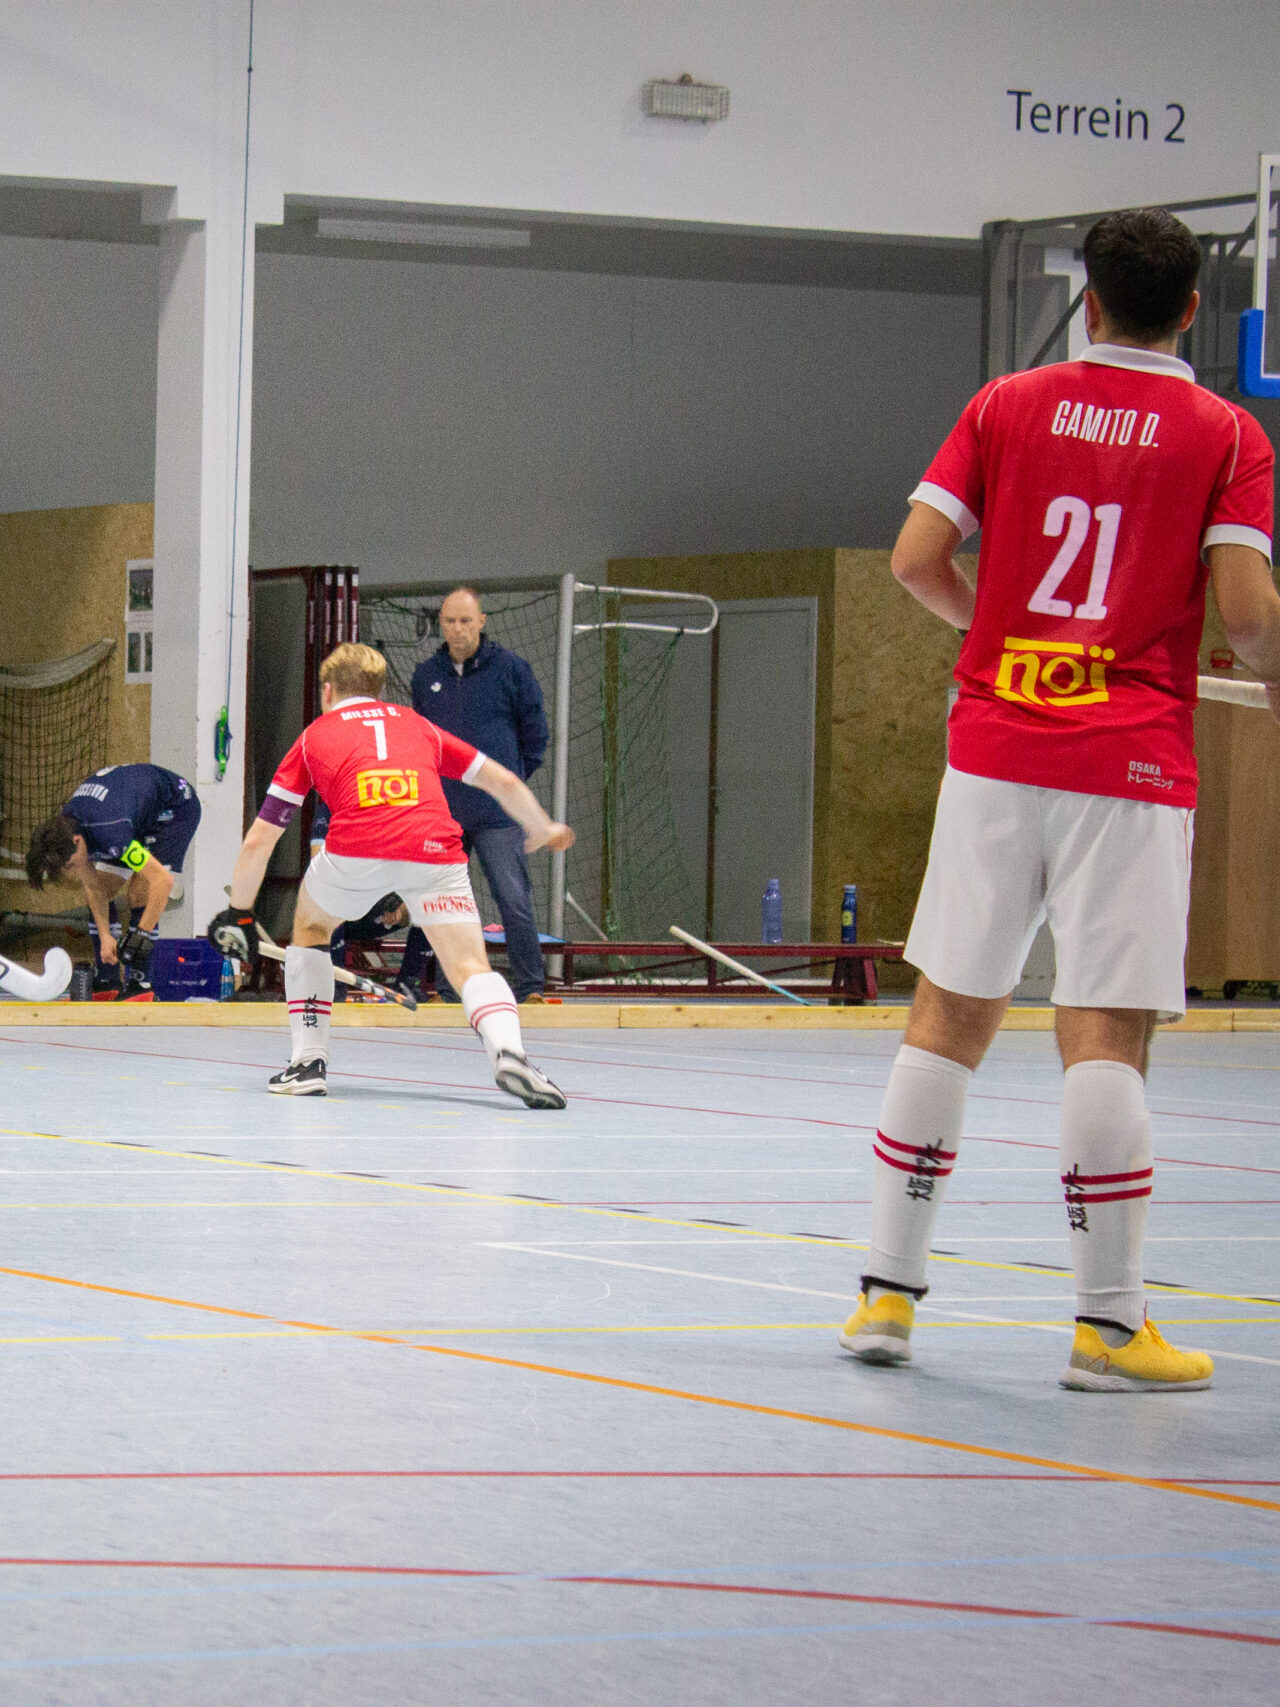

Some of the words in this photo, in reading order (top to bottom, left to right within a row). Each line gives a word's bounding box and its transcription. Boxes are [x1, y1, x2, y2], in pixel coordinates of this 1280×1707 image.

[1006, 89, 1149, 141] Terrein
[1163, 101, 1186, 144] 2
[1051, 400, 1138, 446] GAMITO
[1138, 412, 1160, 448] D.
[1027, 495, 1122, 620] 21
[1127, 773, 1174, 790] トレーニング
[1128, 760, 1162, 777] OSAKA
[127, 847, 145, 867] C
